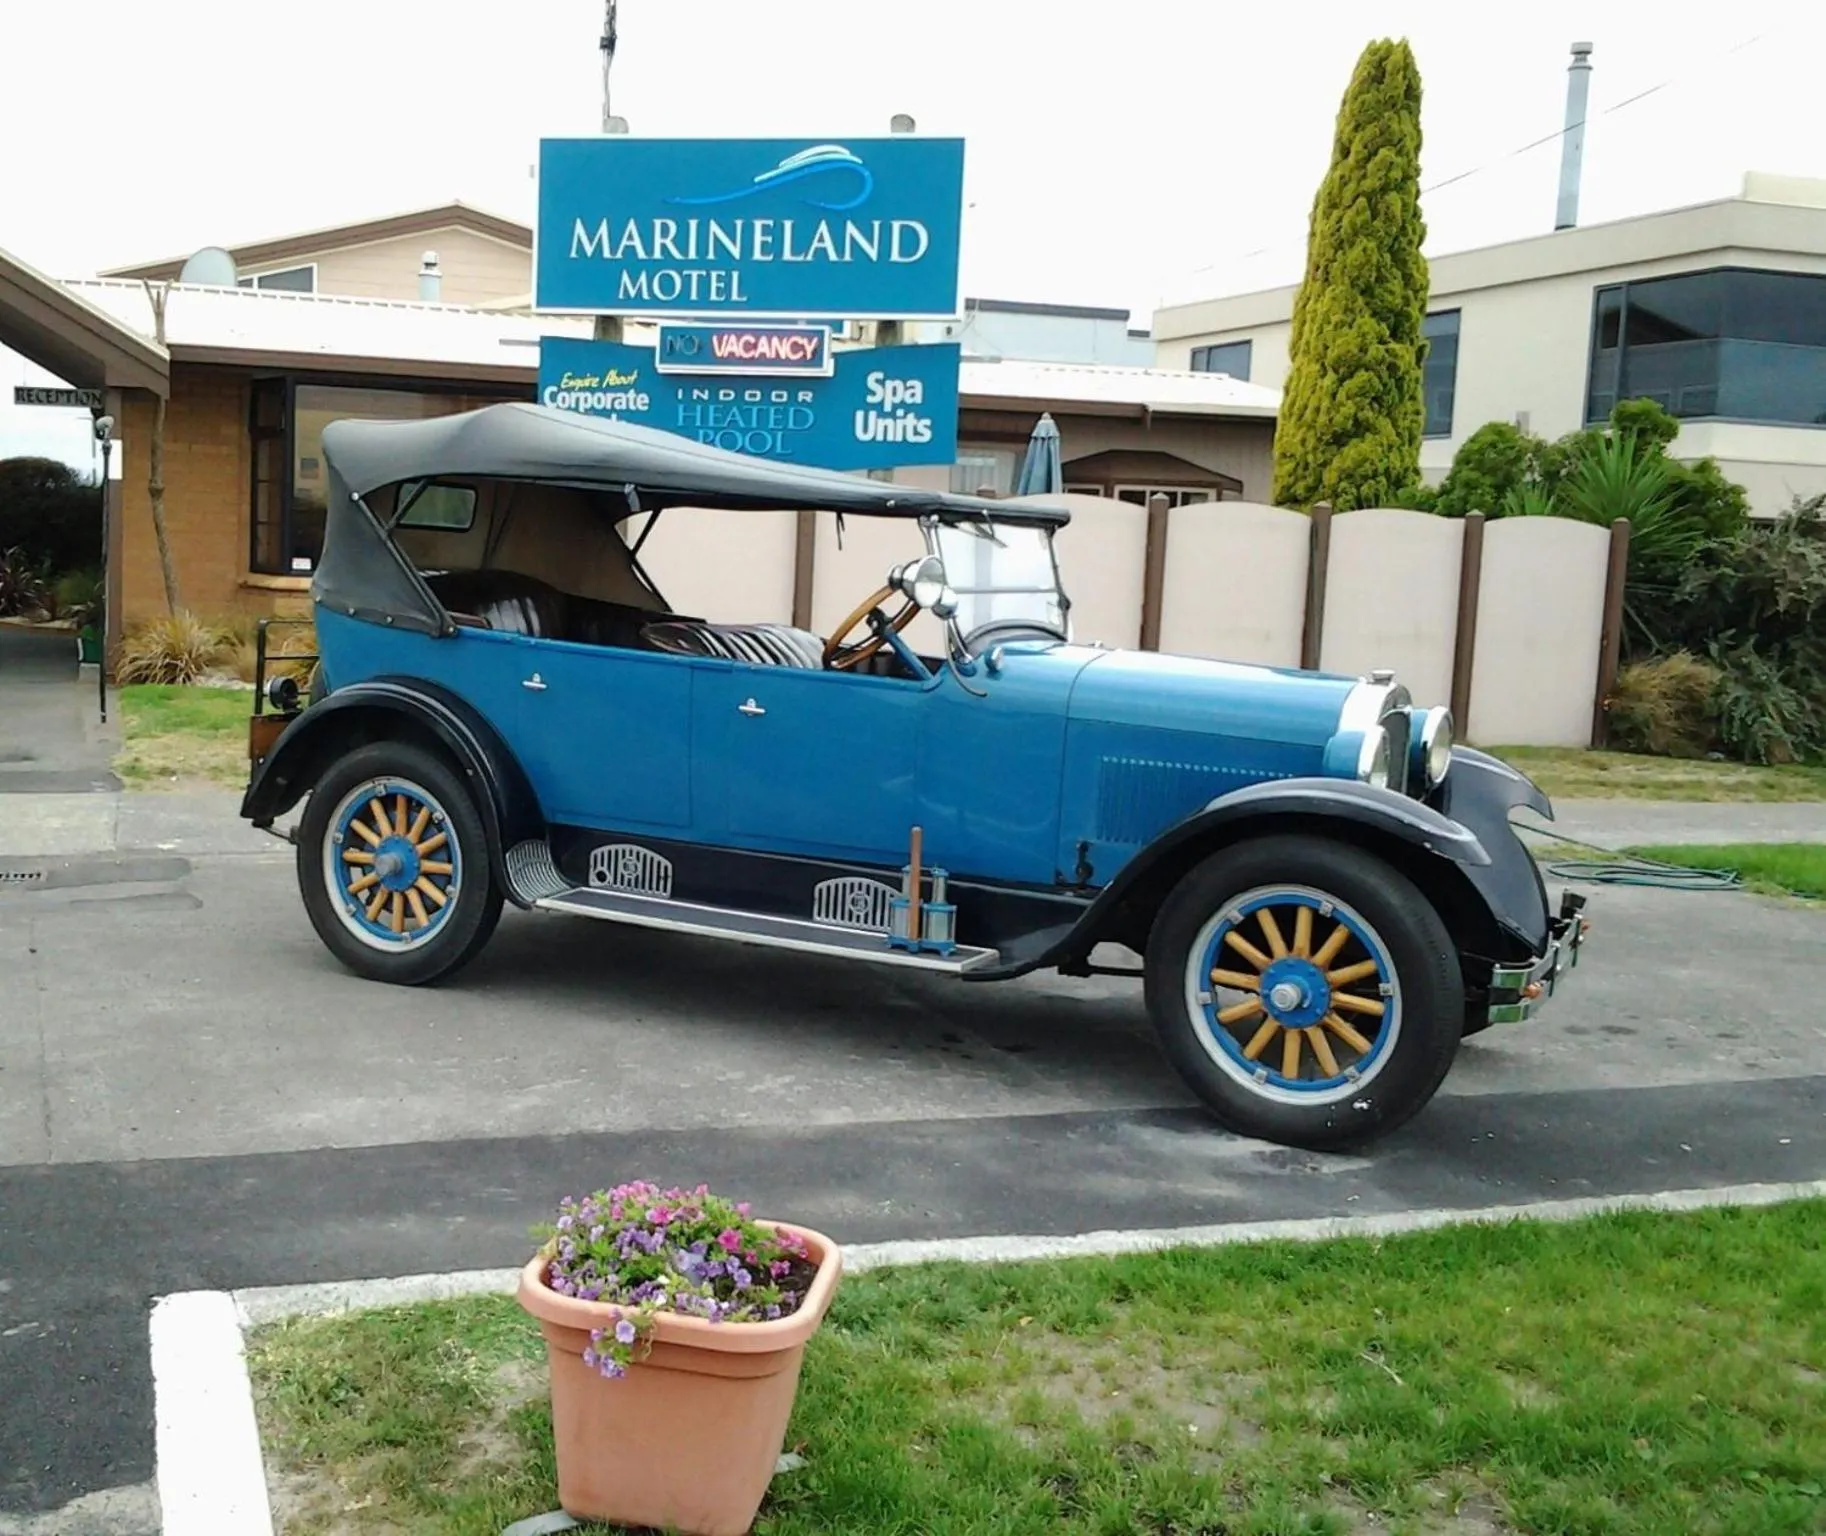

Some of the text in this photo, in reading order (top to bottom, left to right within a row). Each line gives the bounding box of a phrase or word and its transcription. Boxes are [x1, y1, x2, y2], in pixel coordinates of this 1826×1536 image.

[569, 217, 930, 263] MARINELAND
[618, 269, 748, 301] MOTEL
[665, 333, 819, 361] NO VACANCY
[602, 368, 639, 388] About
[866, 371, 923, 412] Spa
[16, 387, 102, 405] RECEPTION
[543, 385, 650, 412] Corporate
[677, 388, 814, 403] INDOOR
[676, 404, 815, 430] HEATED
[855, 408, 932, 443] Units
[699, 429, 792, 454] POOL
